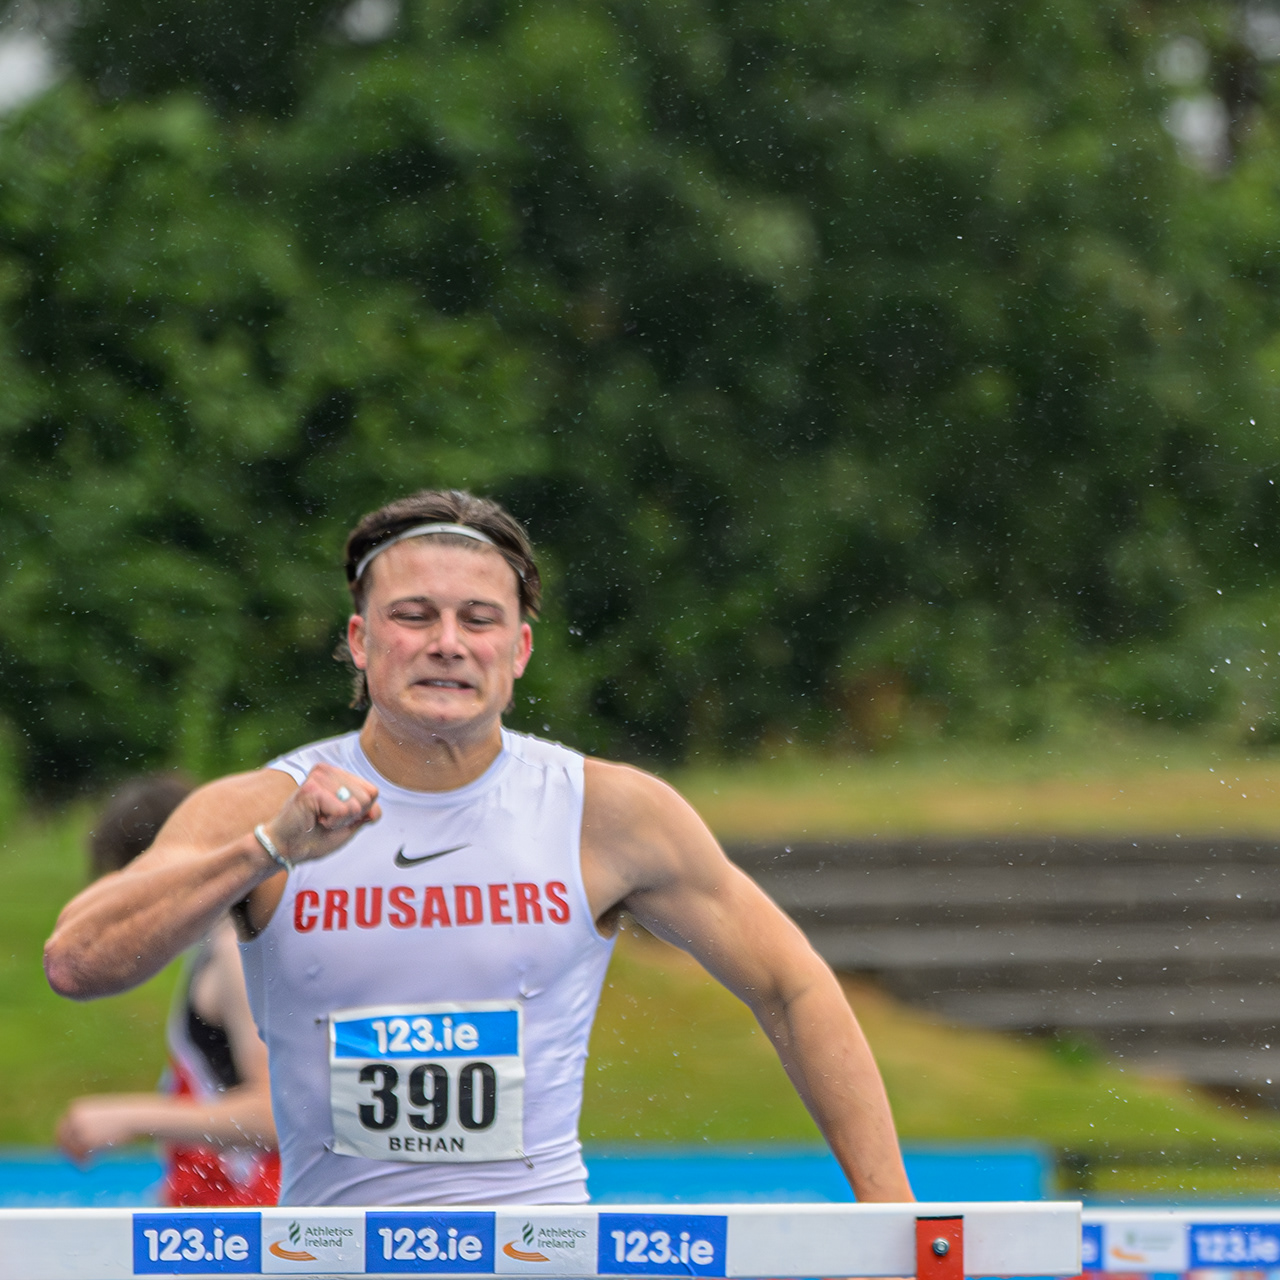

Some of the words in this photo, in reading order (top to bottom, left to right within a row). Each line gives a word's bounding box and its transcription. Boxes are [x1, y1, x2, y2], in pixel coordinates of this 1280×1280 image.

[293, 881, 571, 934] CRUSADERS
[372, 1017, 480, 1055] 123.ie
[358, 1061, 497, 1133] 390
[389, 1137, 465, 1152] BEHAN
[144, 1228, 249, 1262] 123.ie
[304, 1226, 353, 1238] Athletics
[304, 1237, 343, 1248] Ireland
[378, 1227, 483, 1262] 123.ie
[538, 1227, 587, 1239] Athletics
[538, 1239, 576, 1249] Ireland
[611, 1230, 714, 1265] 123.ie
